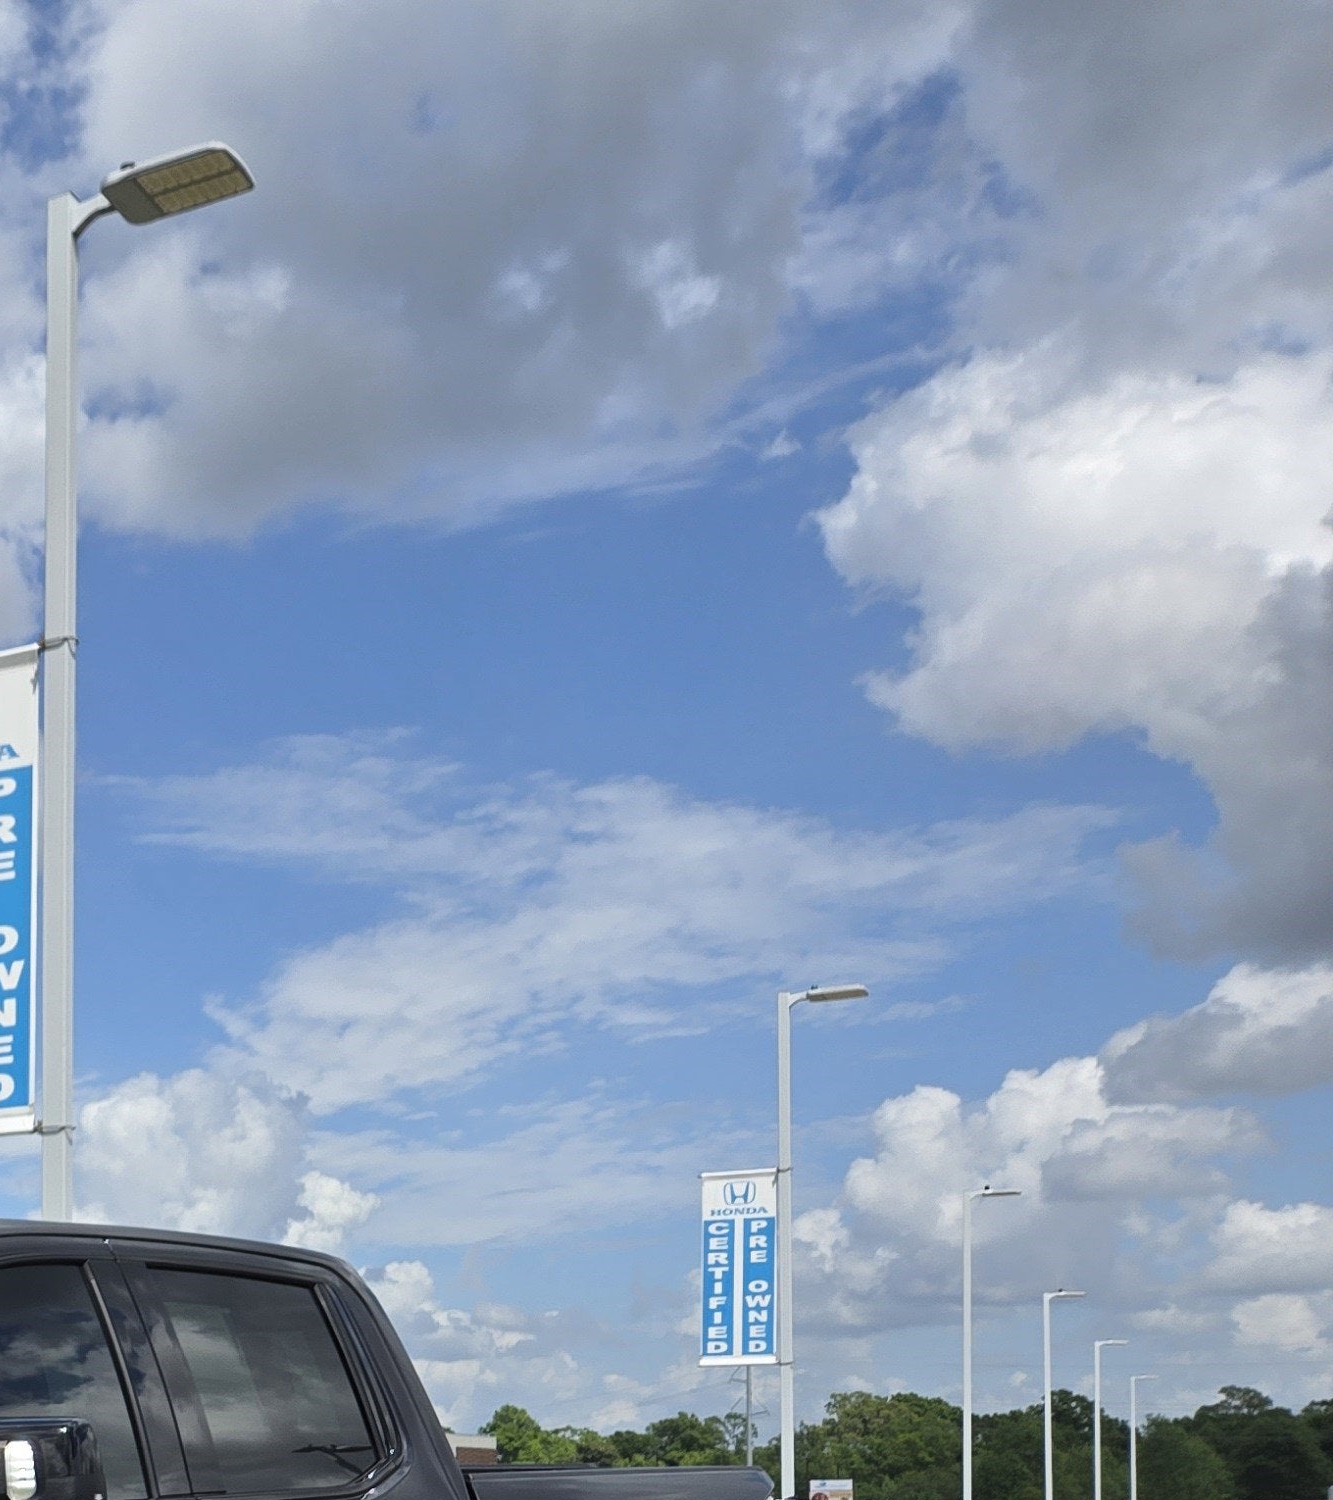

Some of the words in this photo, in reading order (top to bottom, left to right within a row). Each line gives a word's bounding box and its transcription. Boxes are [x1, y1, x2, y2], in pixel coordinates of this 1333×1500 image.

[710, 1206, 769, 1217] HONDA
[749, 1220, 768, 1264] PRE
[706, 1221, 730, 1354] CERTIFIED
[745, 1279, 772, 1353] OWNED
